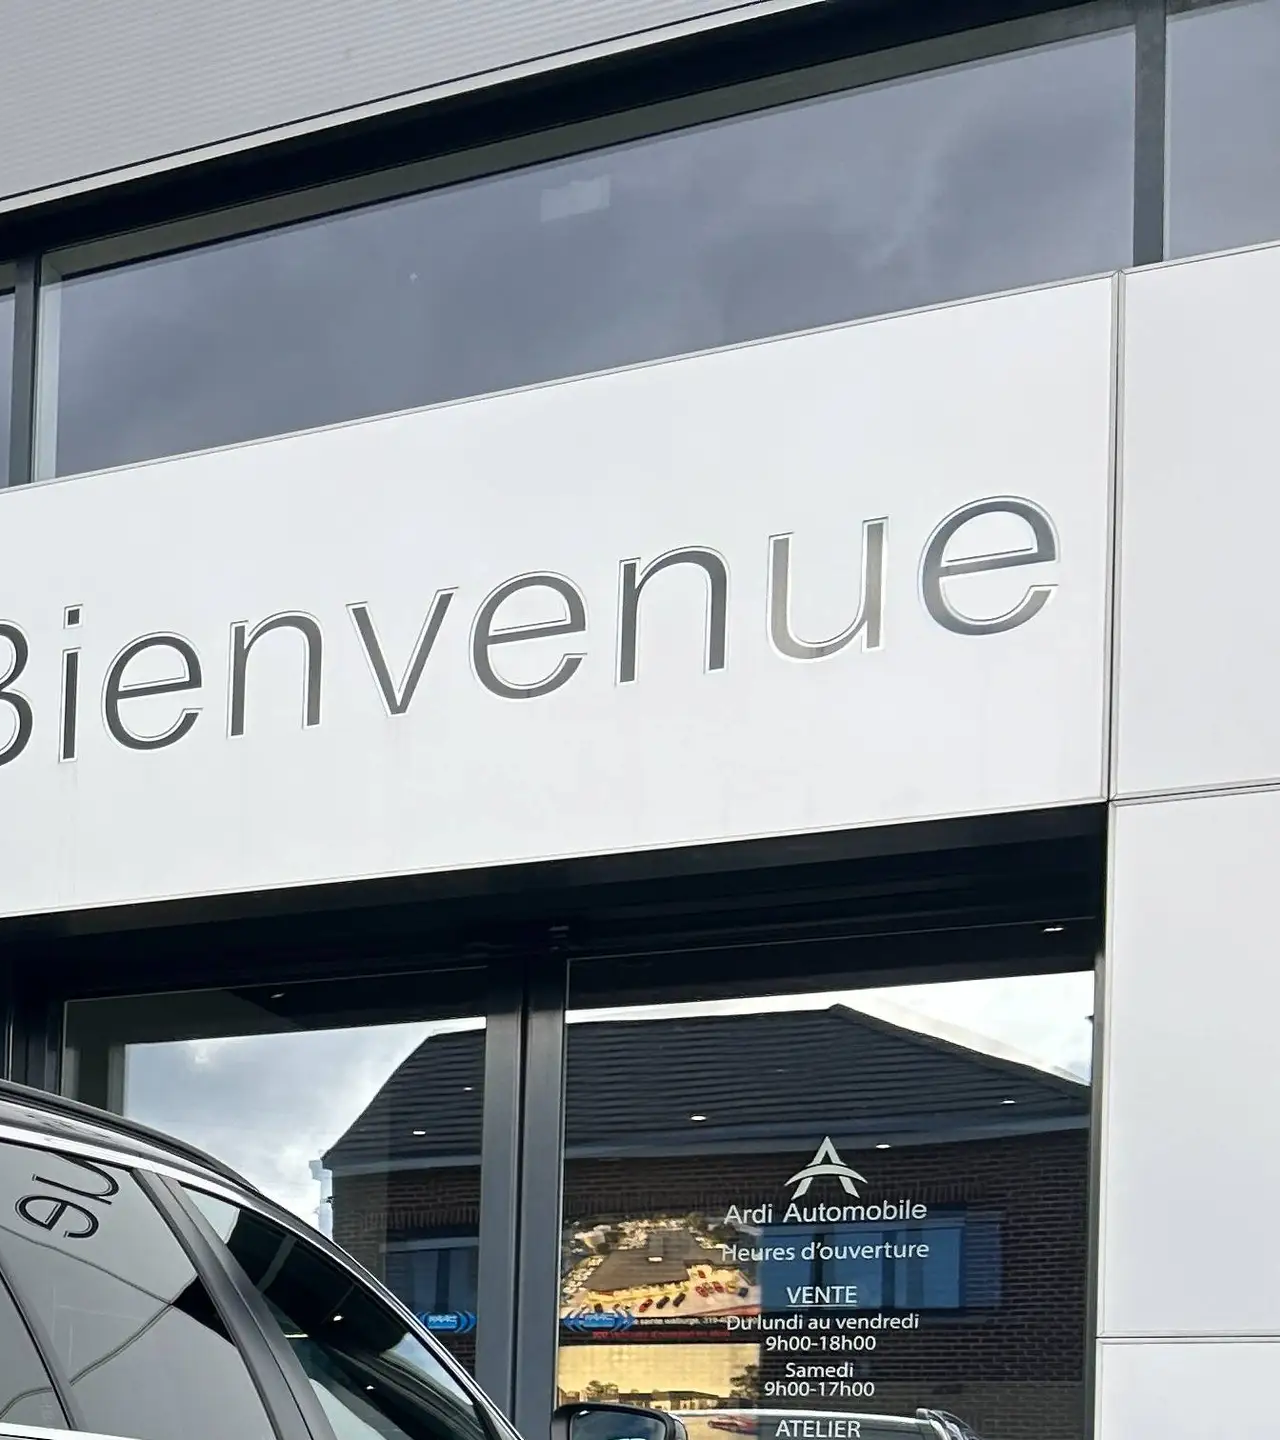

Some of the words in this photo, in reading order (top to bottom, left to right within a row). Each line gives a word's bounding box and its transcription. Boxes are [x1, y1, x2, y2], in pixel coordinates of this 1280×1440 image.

[723, 1203, 773, 1225] Ardi
[782, 1199, 928, 1224] Automobile
[721, 1243, 795, 1262] Heures
[786, 1285, 858, 1304] VENTE
[726, 1315, 753, 1331] Du
[756, 1314, 804, 1331] lundi
[807, 1317, 832, 1330] au
[834, 1313, 920, 1330] vendredi
[765, 1335, 877, 1352] 9h00-18h00
[785, 1362, 855, 1379] Samedi
[763, 1381, 876, 1398] 9h00-17h00
[775, 1420, 862, 1439] ATELIER
